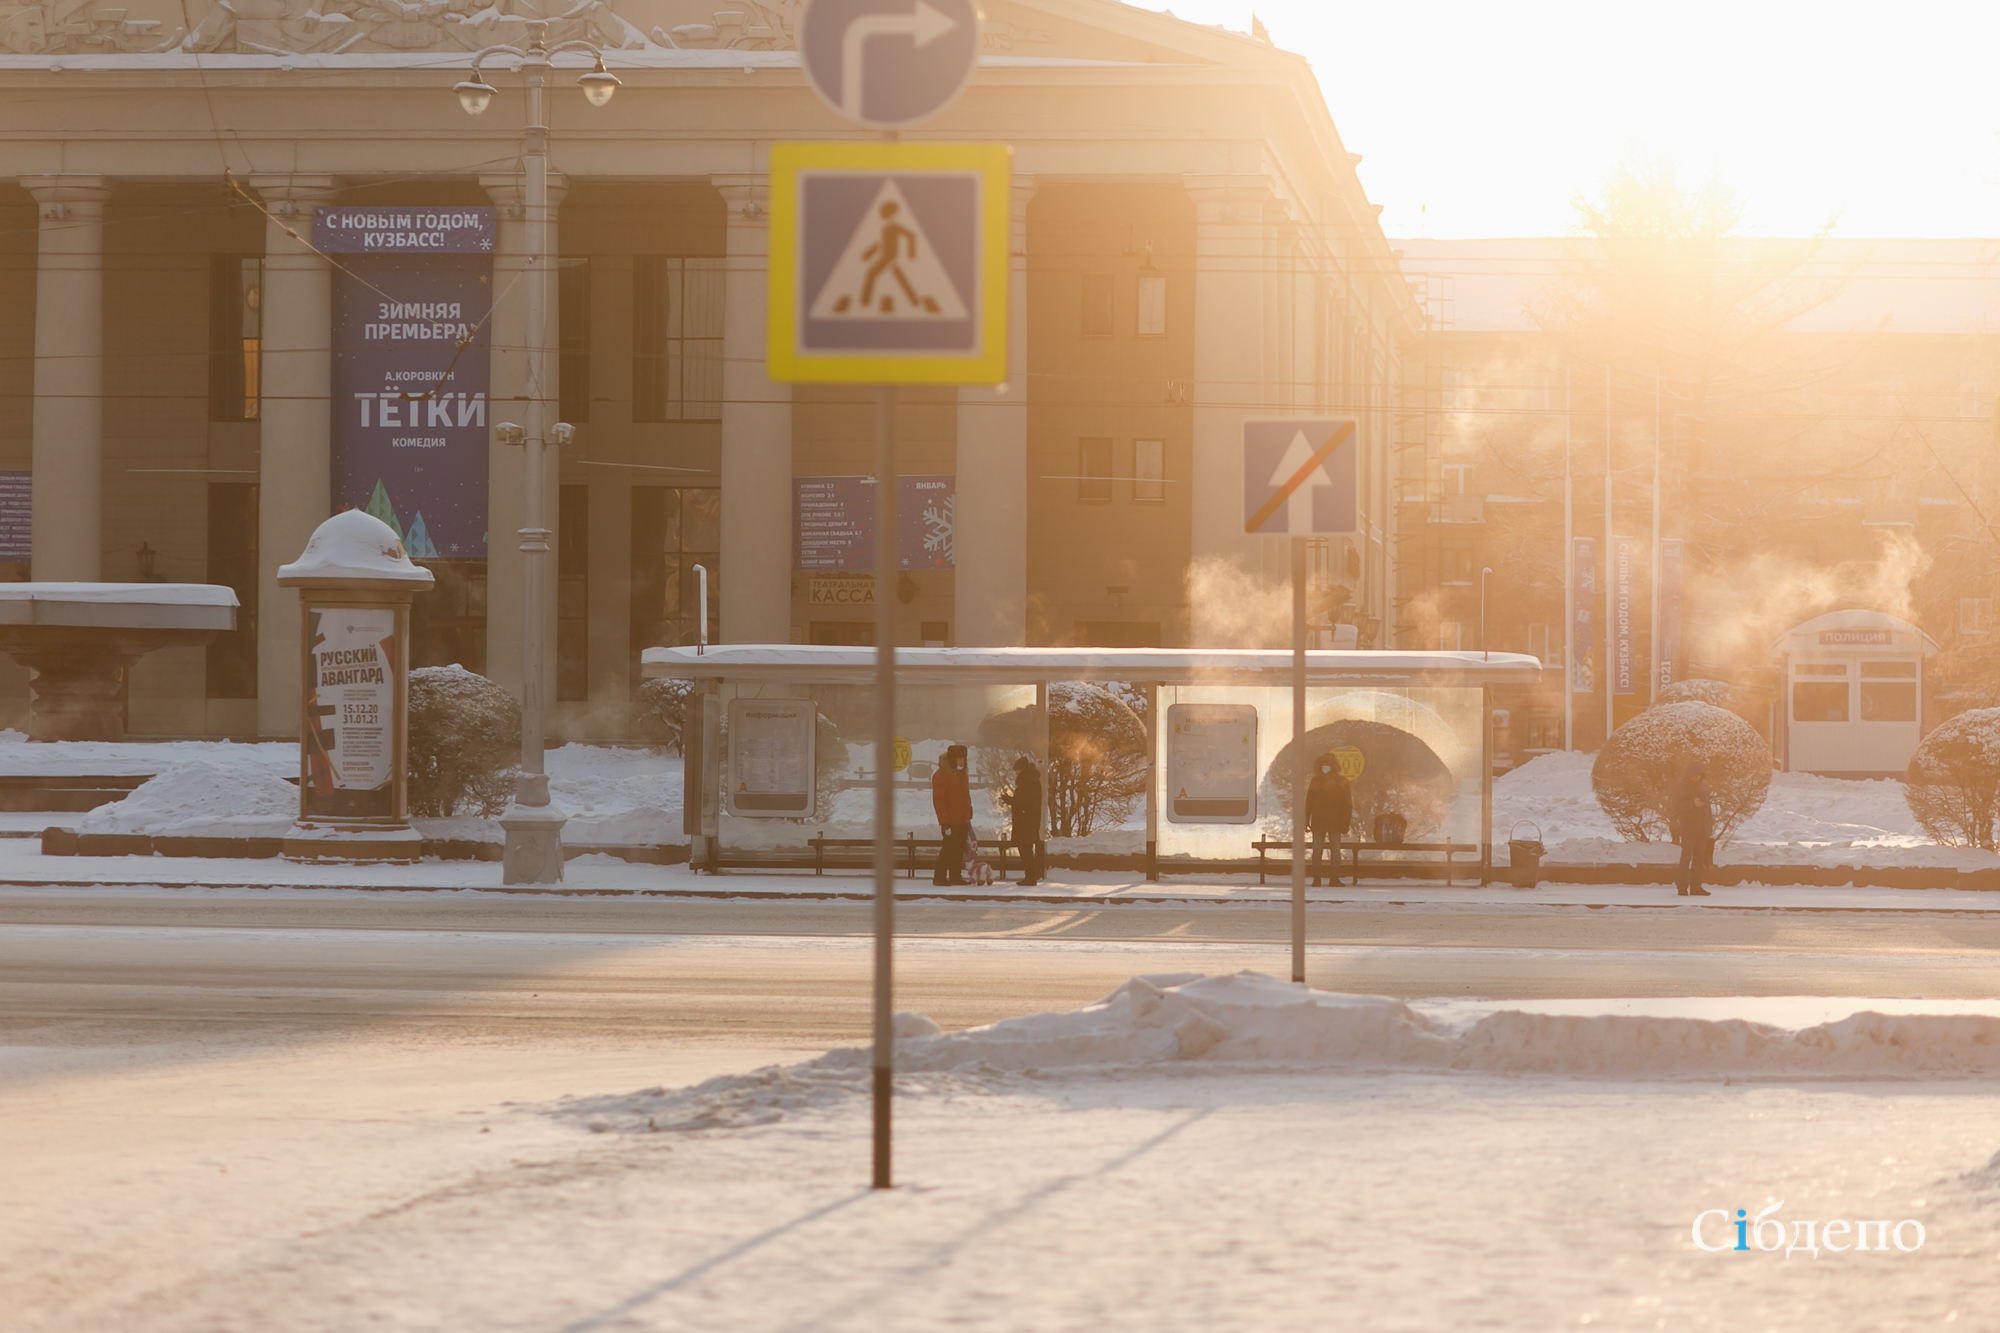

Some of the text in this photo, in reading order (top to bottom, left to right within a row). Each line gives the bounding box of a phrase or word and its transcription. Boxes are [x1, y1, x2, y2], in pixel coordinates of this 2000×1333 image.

[326, 214, 483, 231] С НОВЫМ ГОДОМ,
[364, 232, 444, 247] КУЗБАСС!
[378, 303, 461, 320] ЗИМНЯЯ
[364, 323, 473, 340] ПРЕМЬЕРА
[385, 372, 455, 382] А.КОРОВКИН
[354, 385, 486, 428] ТЁТКИ
[392, 438, 446, 448] КОМЕДИЯ
[1619, 552, 1628, 594] НОВЫМ
[812, 589, 874, 603] КАССА
[1618, 597, 1628, 637] ГОДОМ,
[1825, 632, 1886, 643] ПОЛИЦИЯ
[320, 644, 378, 666] РУССКИЙ
[1620, 639, 1629, 688] КУЗБАСС!
[321, 667, 384, 687] АВАНГАРД
[343, 704, 378, 714] 15.12.20
[343, 714, 378, 724] 31.01.21
[1185, 717, 1238, 725] Информация
